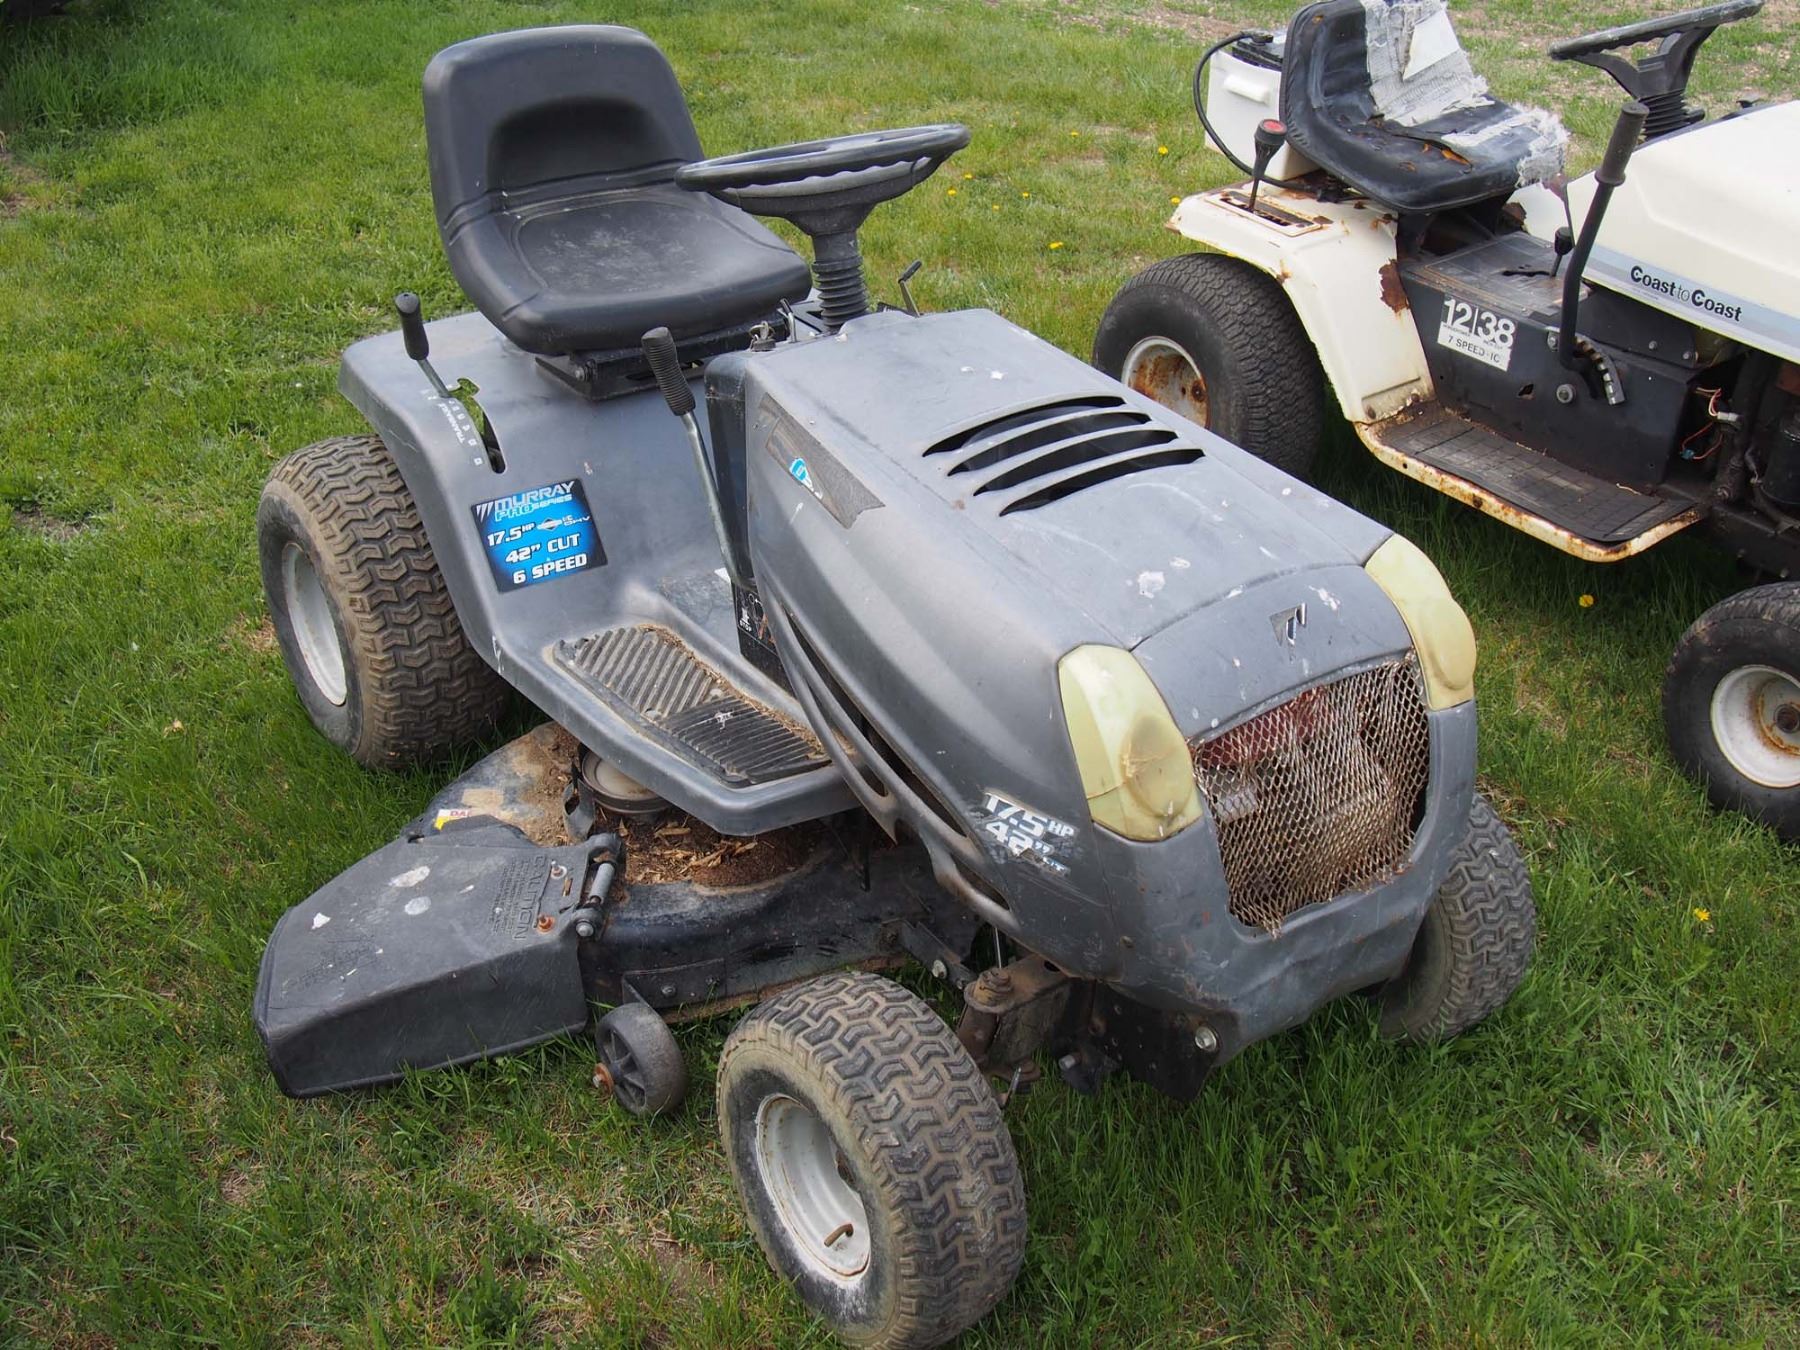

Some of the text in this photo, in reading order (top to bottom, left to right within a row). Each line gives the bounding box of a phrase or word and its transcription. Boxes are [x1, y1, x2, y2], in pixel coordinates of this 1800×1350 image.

[1630, 265, 1676, 297] Coast
[1676, 284, 1691, 302] to
[1691, 289, 1742, 322] Coast
[1448, 335, 1454, 344] 7
[494, 481, 575, 511] MURRAY
[547, 533, 581, 553] CUT
[512, 553, 588, 584] 6 SPEED
[512, 854, 547, 940] CAUTION
